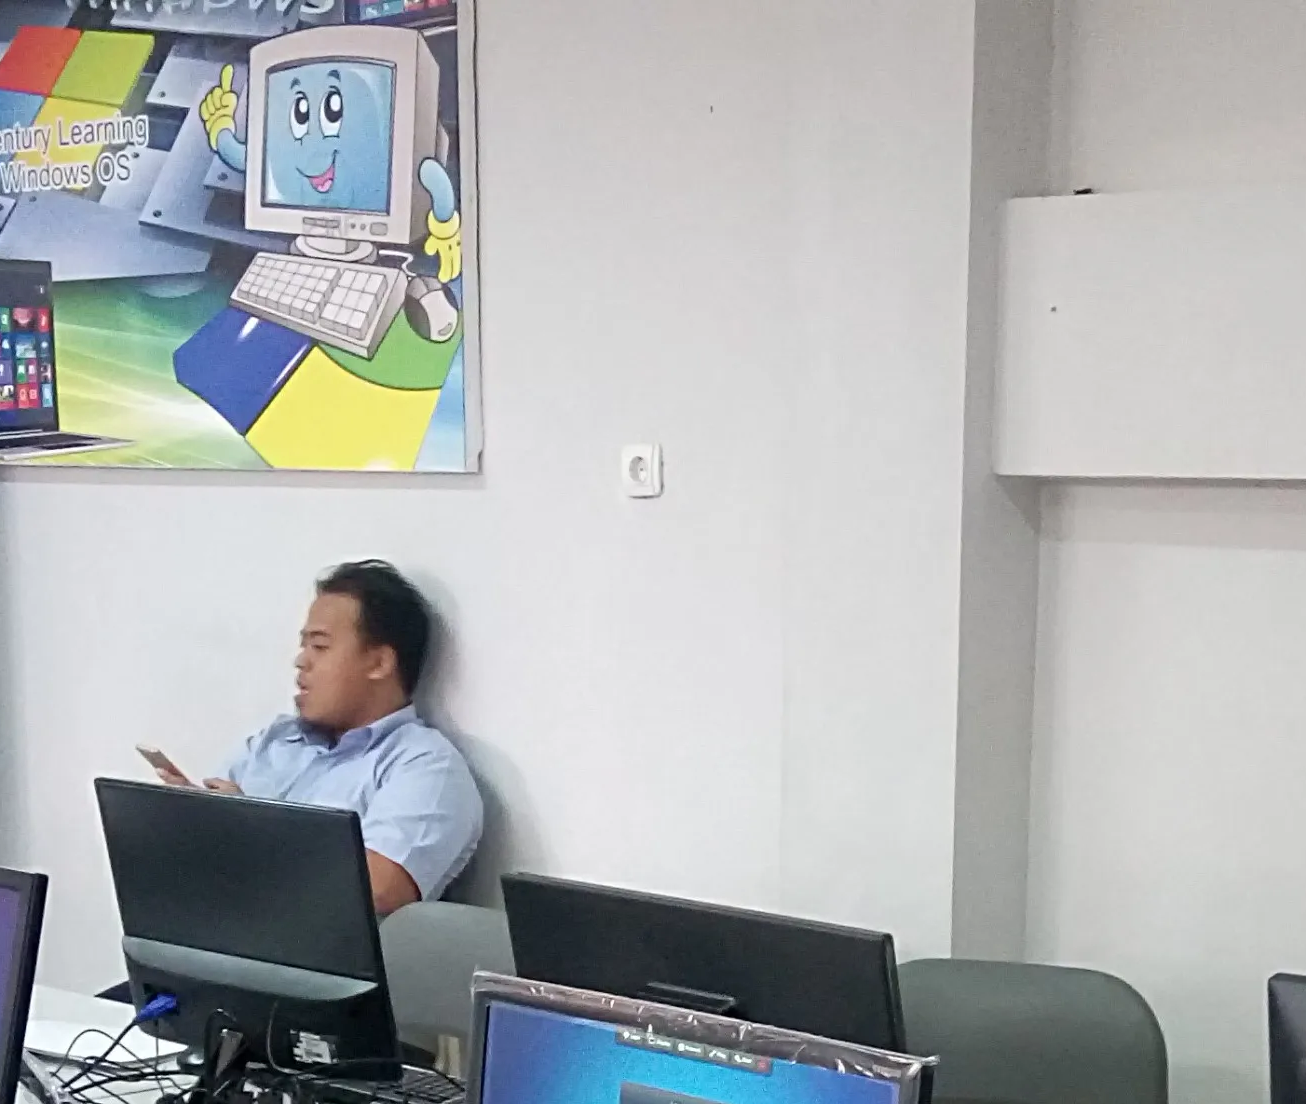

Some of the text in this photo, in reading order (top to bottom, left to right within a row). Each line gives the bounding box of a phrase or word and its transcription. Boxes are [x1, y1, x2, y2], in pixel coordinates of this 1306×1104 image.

[57, 113, 149, 147] Learning
[0, 160, 93, 192] Windows
[97, 153, 133, 183] OS
